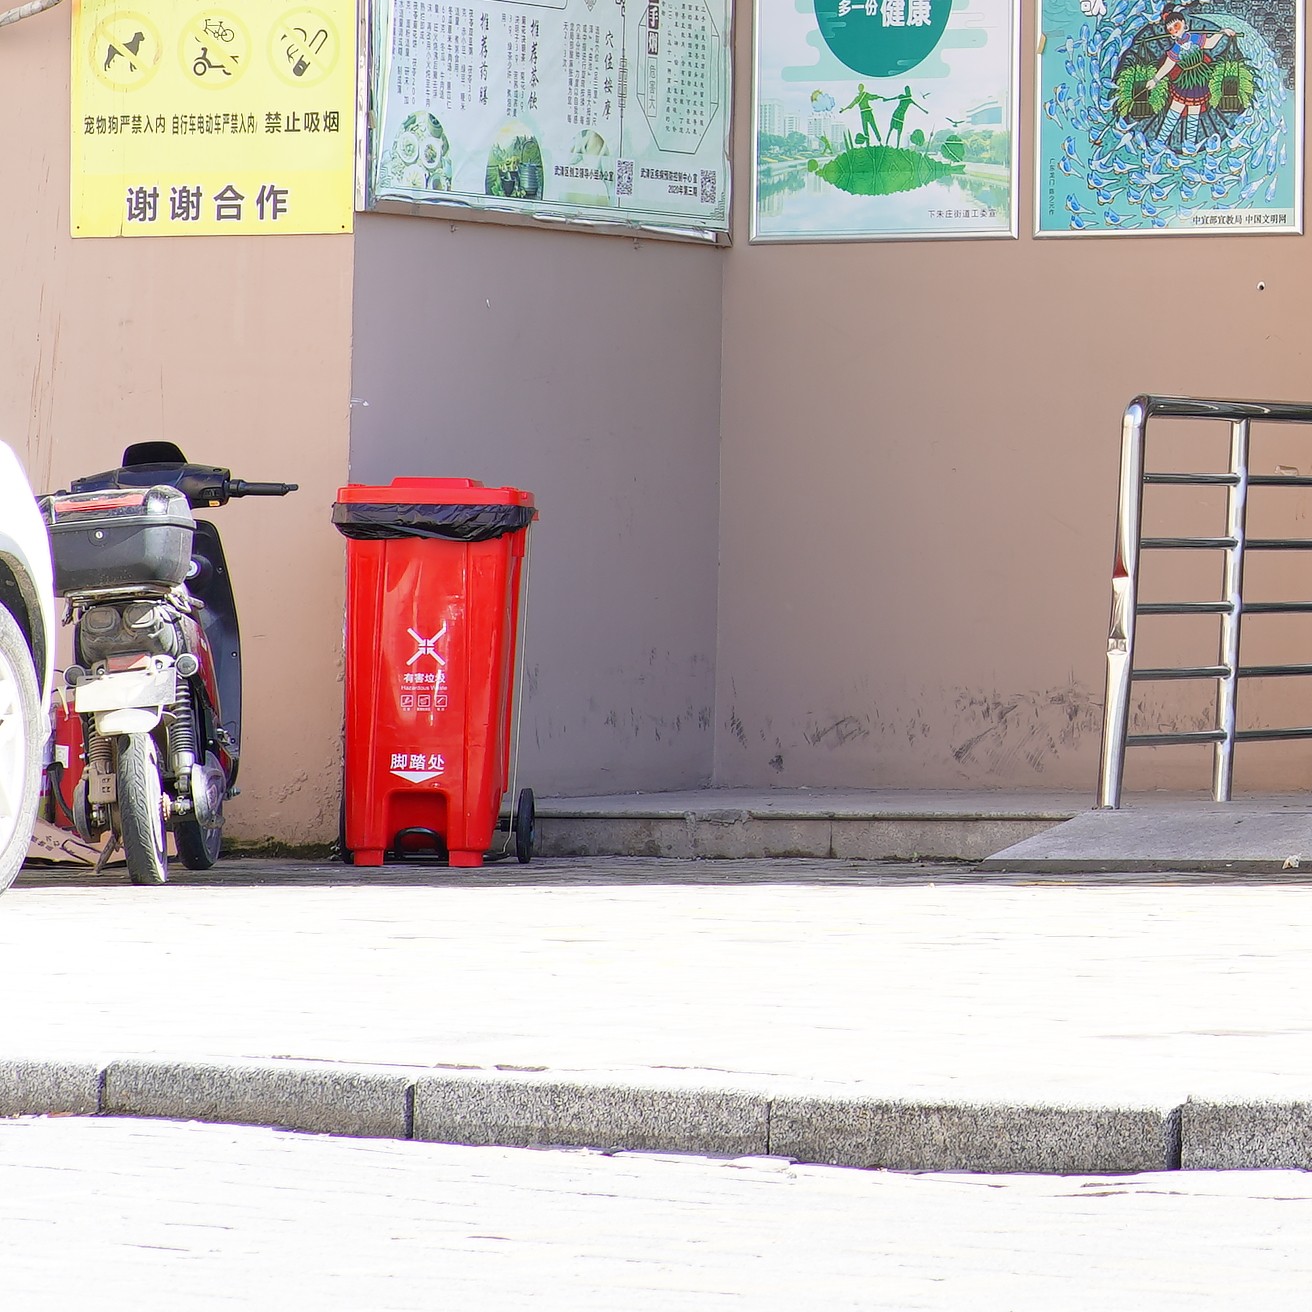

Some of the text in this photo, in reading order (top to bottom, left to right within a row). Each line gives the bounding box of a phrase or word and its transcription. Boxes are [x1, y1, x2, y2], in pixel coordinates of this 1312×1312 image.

[84, 111, 340, 135] 宠物狗严禁入内 自行车电动车严禁入内 禁止吸烟
[126, 185, 289, 222] 谢谢合作
[390, 753, 444, 770] 脚踏处
